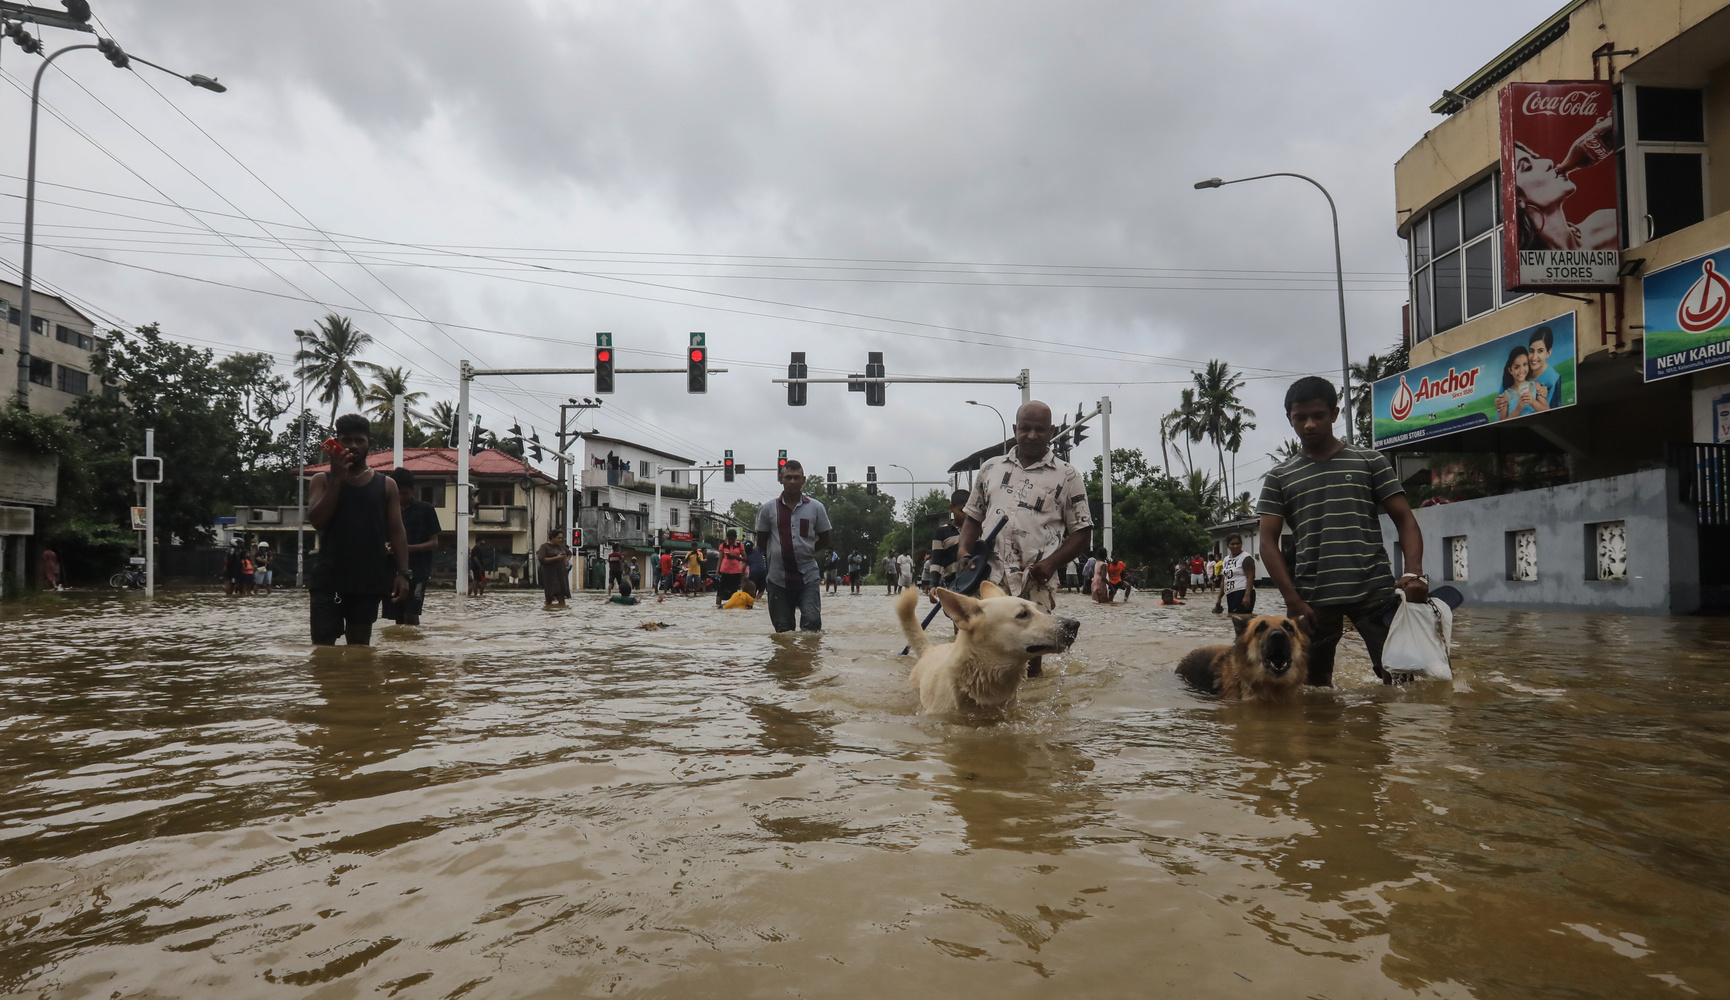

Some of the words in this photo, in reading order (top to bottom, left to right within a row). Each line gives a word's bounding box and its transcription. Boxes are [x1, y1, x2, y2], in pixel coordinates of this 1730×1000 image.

[1522, 90, 1601, 116] Coca-Cola
[1520, 251, 1546, 266] NEW
[1550, 251, 1617, 266] KARUNASIRI
[1546, 267, 1593, 278] STORES
[1657, 351, 1687, 370] NEW
[1414, 367, 1480, 403] Anchor
[1452, 391, 1463, 399] Since
[1409, 429, 1426, 440] STORES
